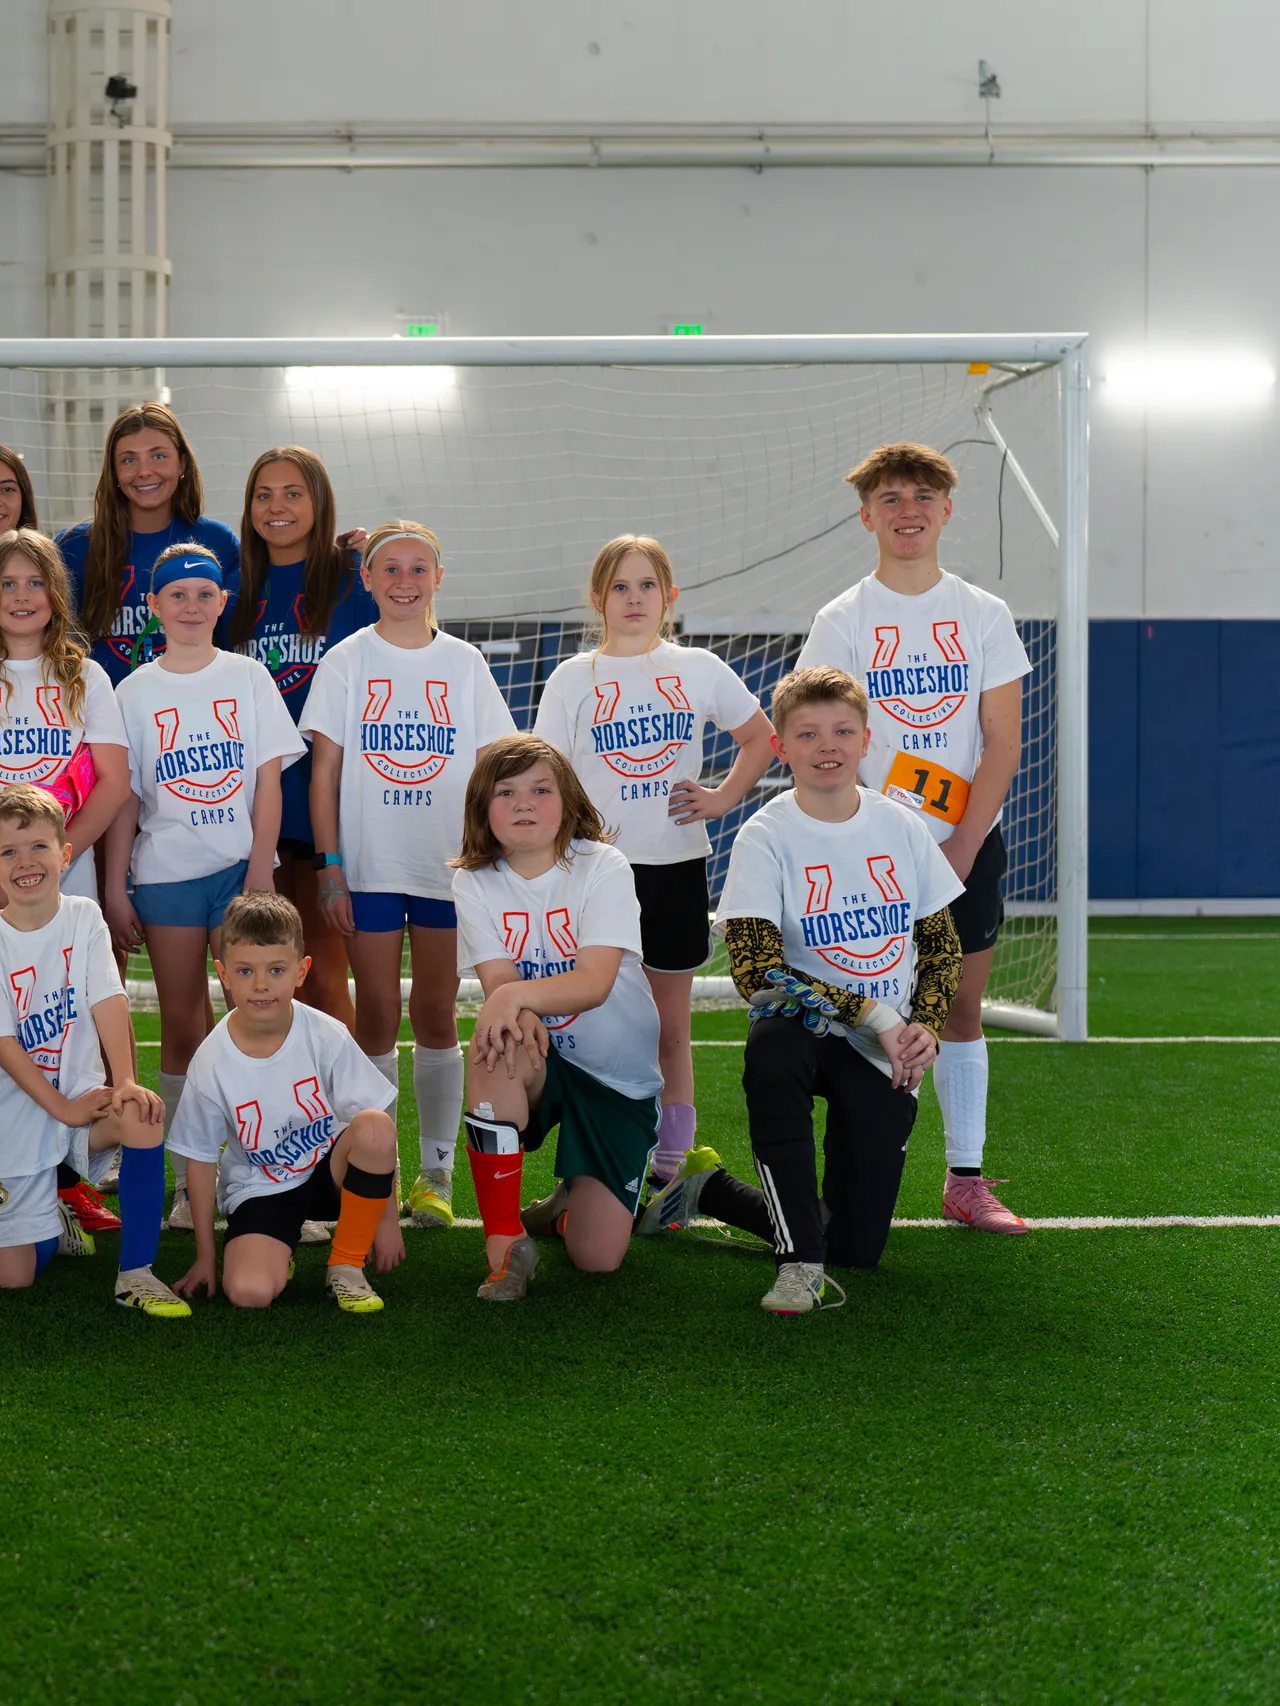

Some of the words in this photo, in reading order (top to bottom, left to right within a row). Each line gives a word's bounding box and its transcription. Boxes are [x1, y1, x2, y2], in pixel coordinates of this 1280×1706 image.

[264, 622, 285, 634] THE
[907, 652, 928, 663] THE
[398, 710, 419, 719] THE
[629, 703, 653, 714] THE
[892, 701, 953, 723] COLLECTIVE
[189, 731, 211, 743] THE
[360, 723, 457, 756] HORSESHOE
[590, 711, 695, 753] HORSESHOE
[902, 731, 948, 750] CAMPS
[156, 740, 244, 784] HORSESHOE
[377, 759, 438, 779] COLLECTIVE
[614, 748, 676, 772] COLLECTIVE
[178, 776, 238, 798] COLLECTIVE
[621, 780, 669, 801] CAMPS
[905, 768, 953, 813] 11
[383, 789, 432, 806] CAMPS
[191, 807, 235, 826] CAMPS
[842, 893, 868, 906] THE
[800, 902, 911, 947] HORSESHOE
[534, 948, 547, 959] TE
[833, 944, 900, 970] COLLECTIVE
[44, 987, 64, 1003] THE
[273, 1120, 293, 1139] THE
